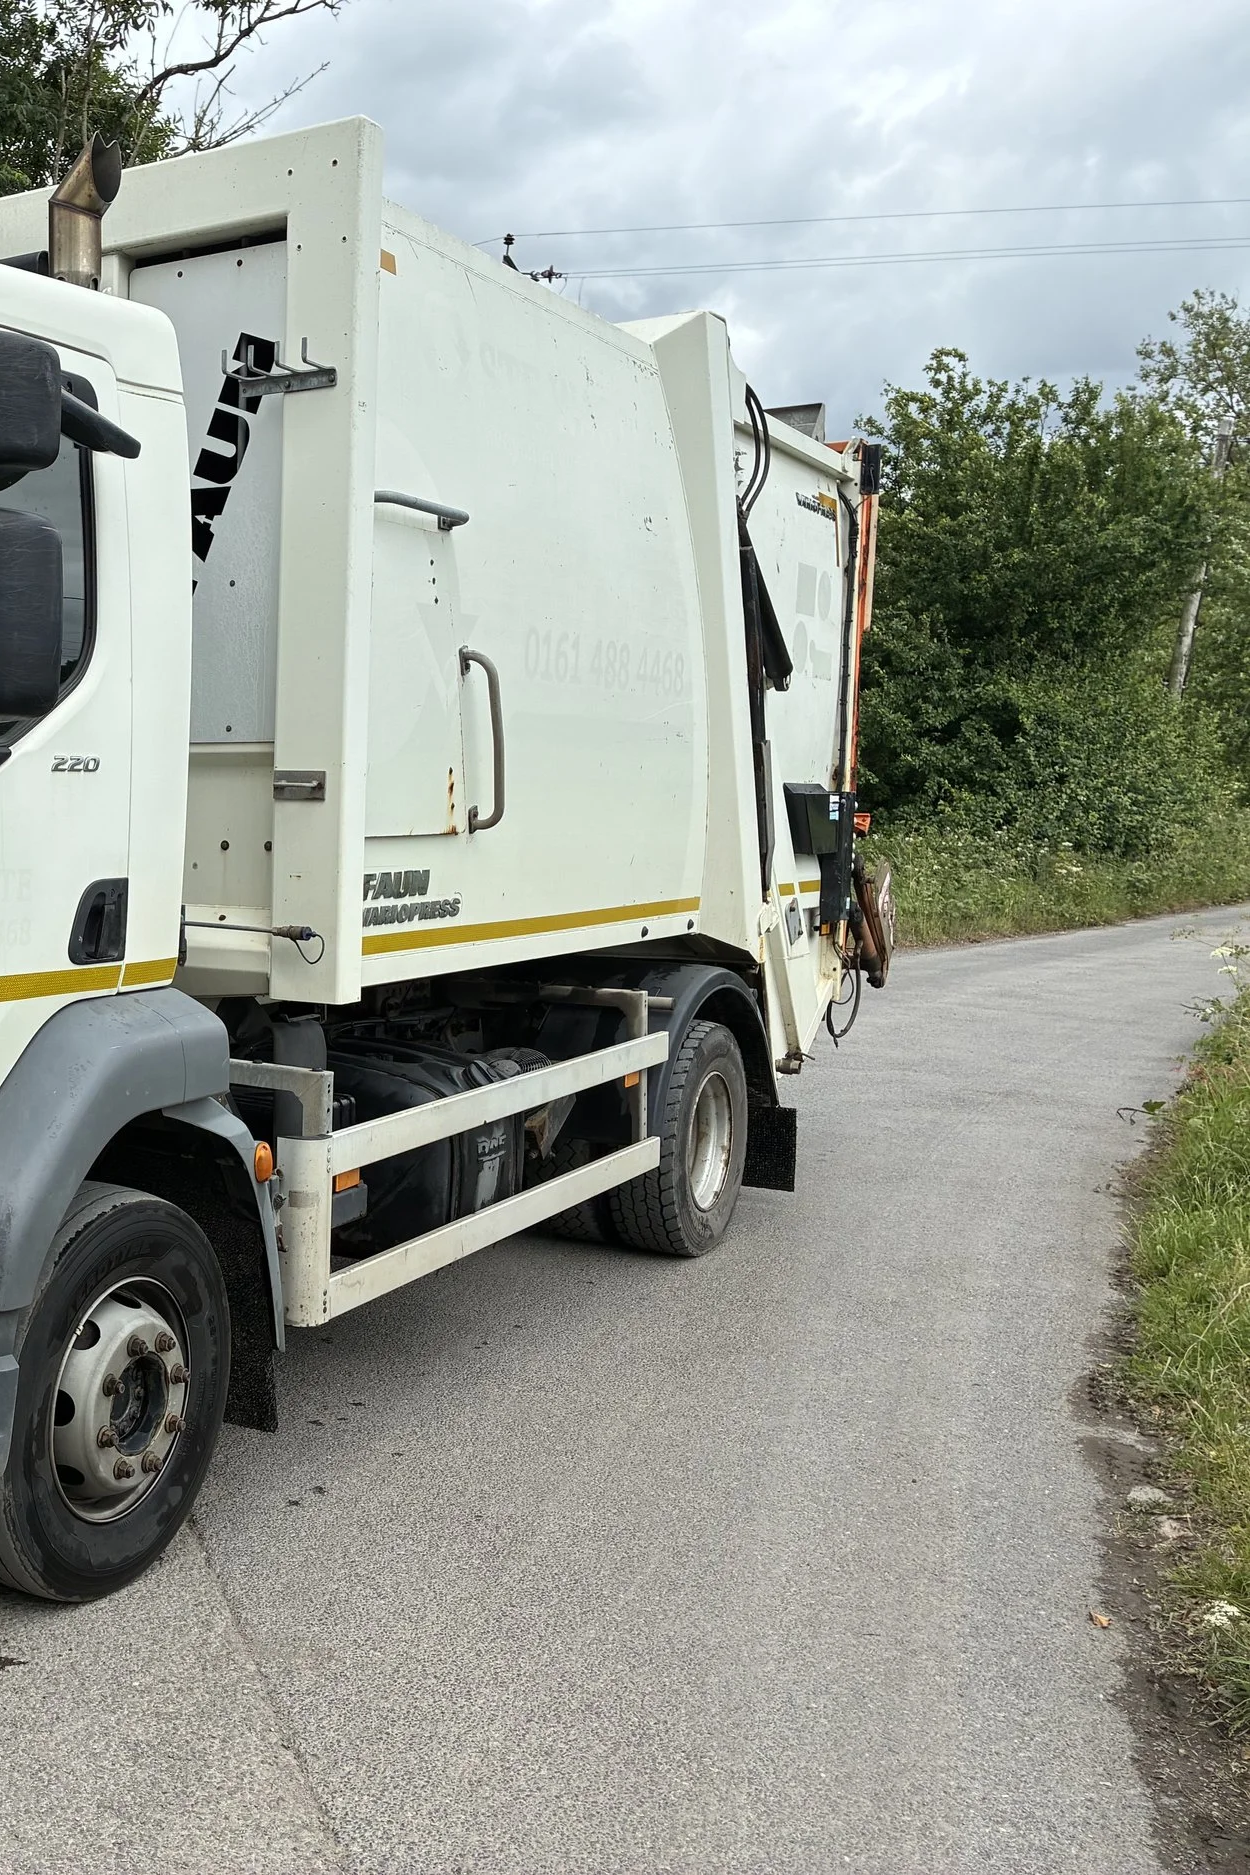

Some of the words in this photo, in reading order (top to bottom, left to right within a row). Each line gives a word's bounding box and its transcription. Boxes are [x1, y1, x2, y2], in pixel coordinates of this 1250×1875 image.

[191, 332, 277, 597] AUN
[524, 625, 581, 684] 0161
[589, 638, 630, 690] 488
[636, 647, 684, 697] 4468
[50, 755, 101, 773] 220
[362, 869, 431, 901] FAUN
